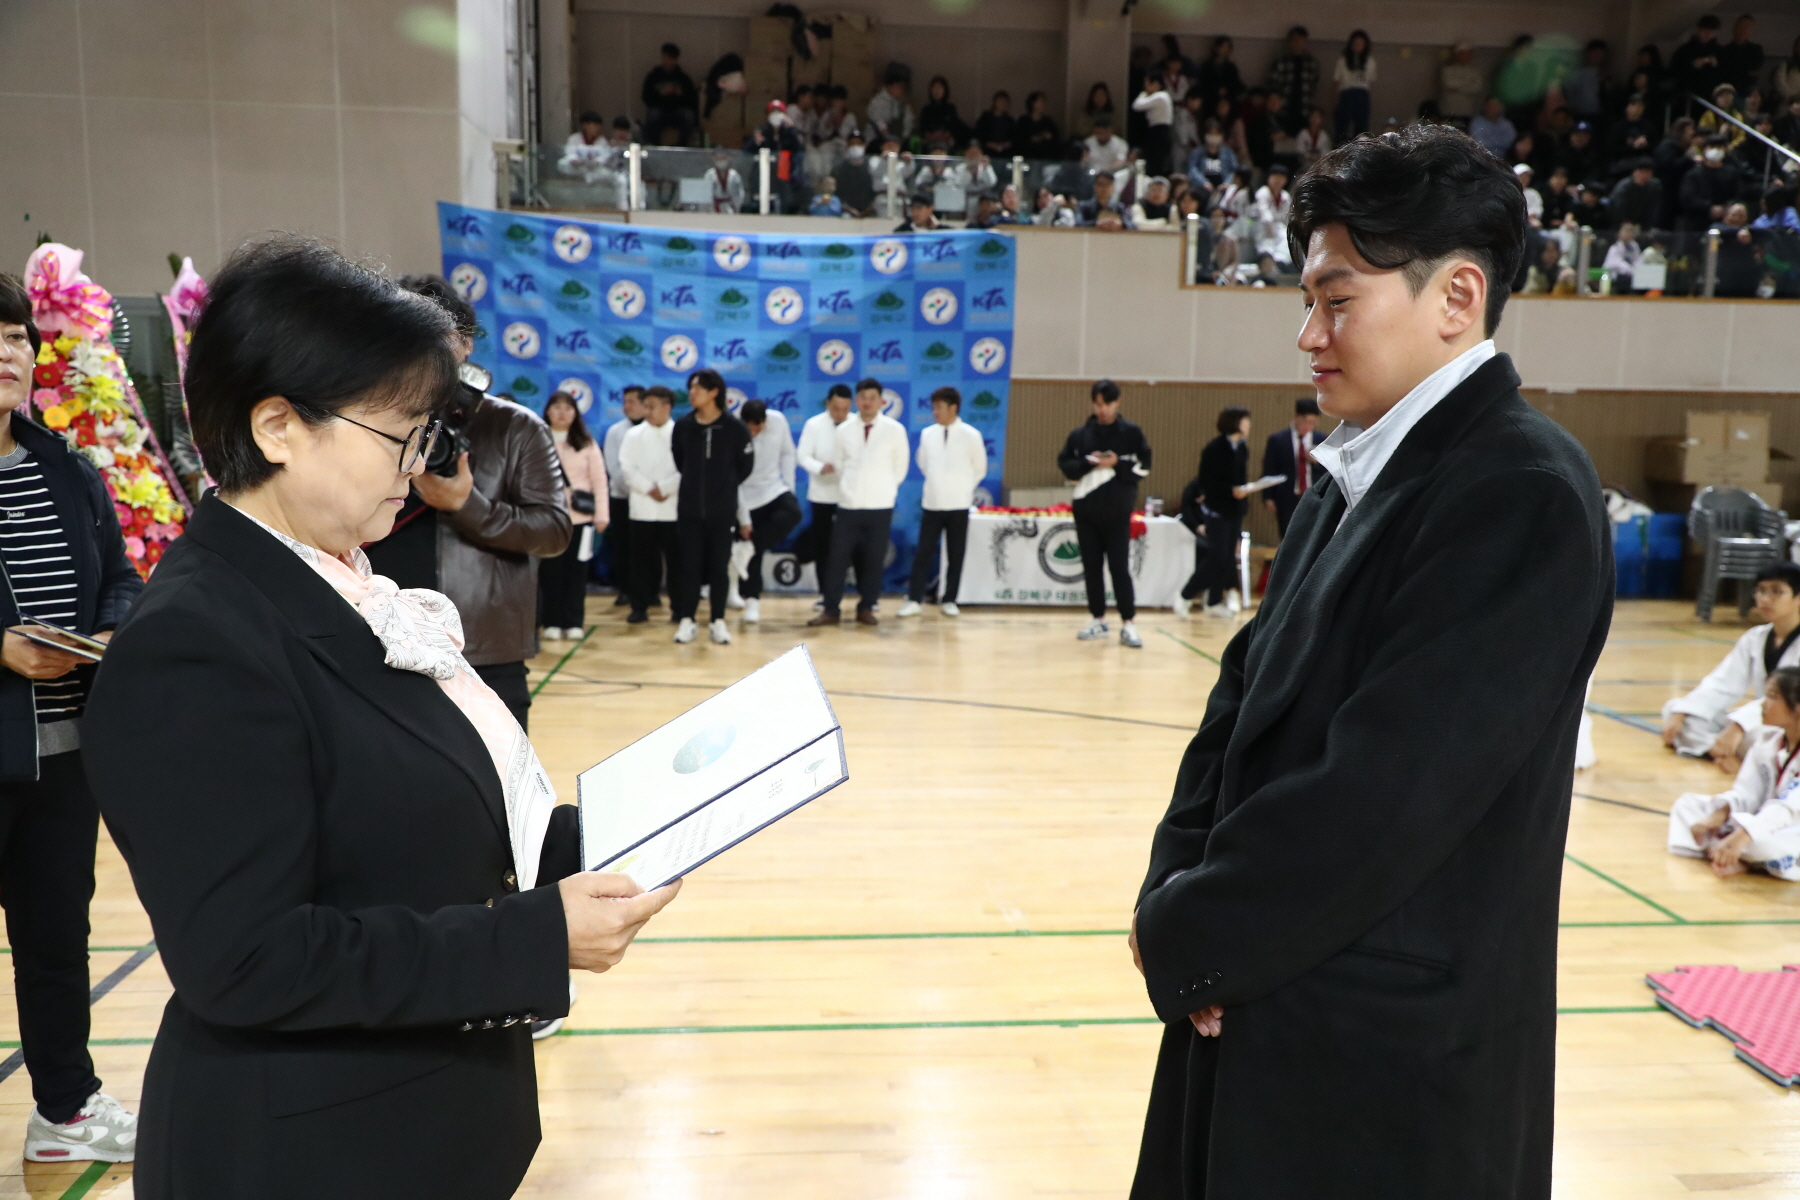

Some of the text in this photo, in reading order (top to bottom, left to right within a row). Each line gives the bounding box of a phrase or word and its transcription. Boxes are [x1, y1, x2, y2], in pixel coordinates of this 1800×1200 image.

[607, 231, 643, 253] KTA
[922, 238, 958, 261] KTA
[502, 274, 538, 295] KTA
[661, 285, 697, 308] KTA
[818, 290, 855, 313] KTA
[972, 287, 1006, 311] KTA
[556, 329, 592, 352] KTA
[713, 339, 748, 361] KTA
[868, 340, 904, 363] KTA
[781, 560, 796, 584] 3
